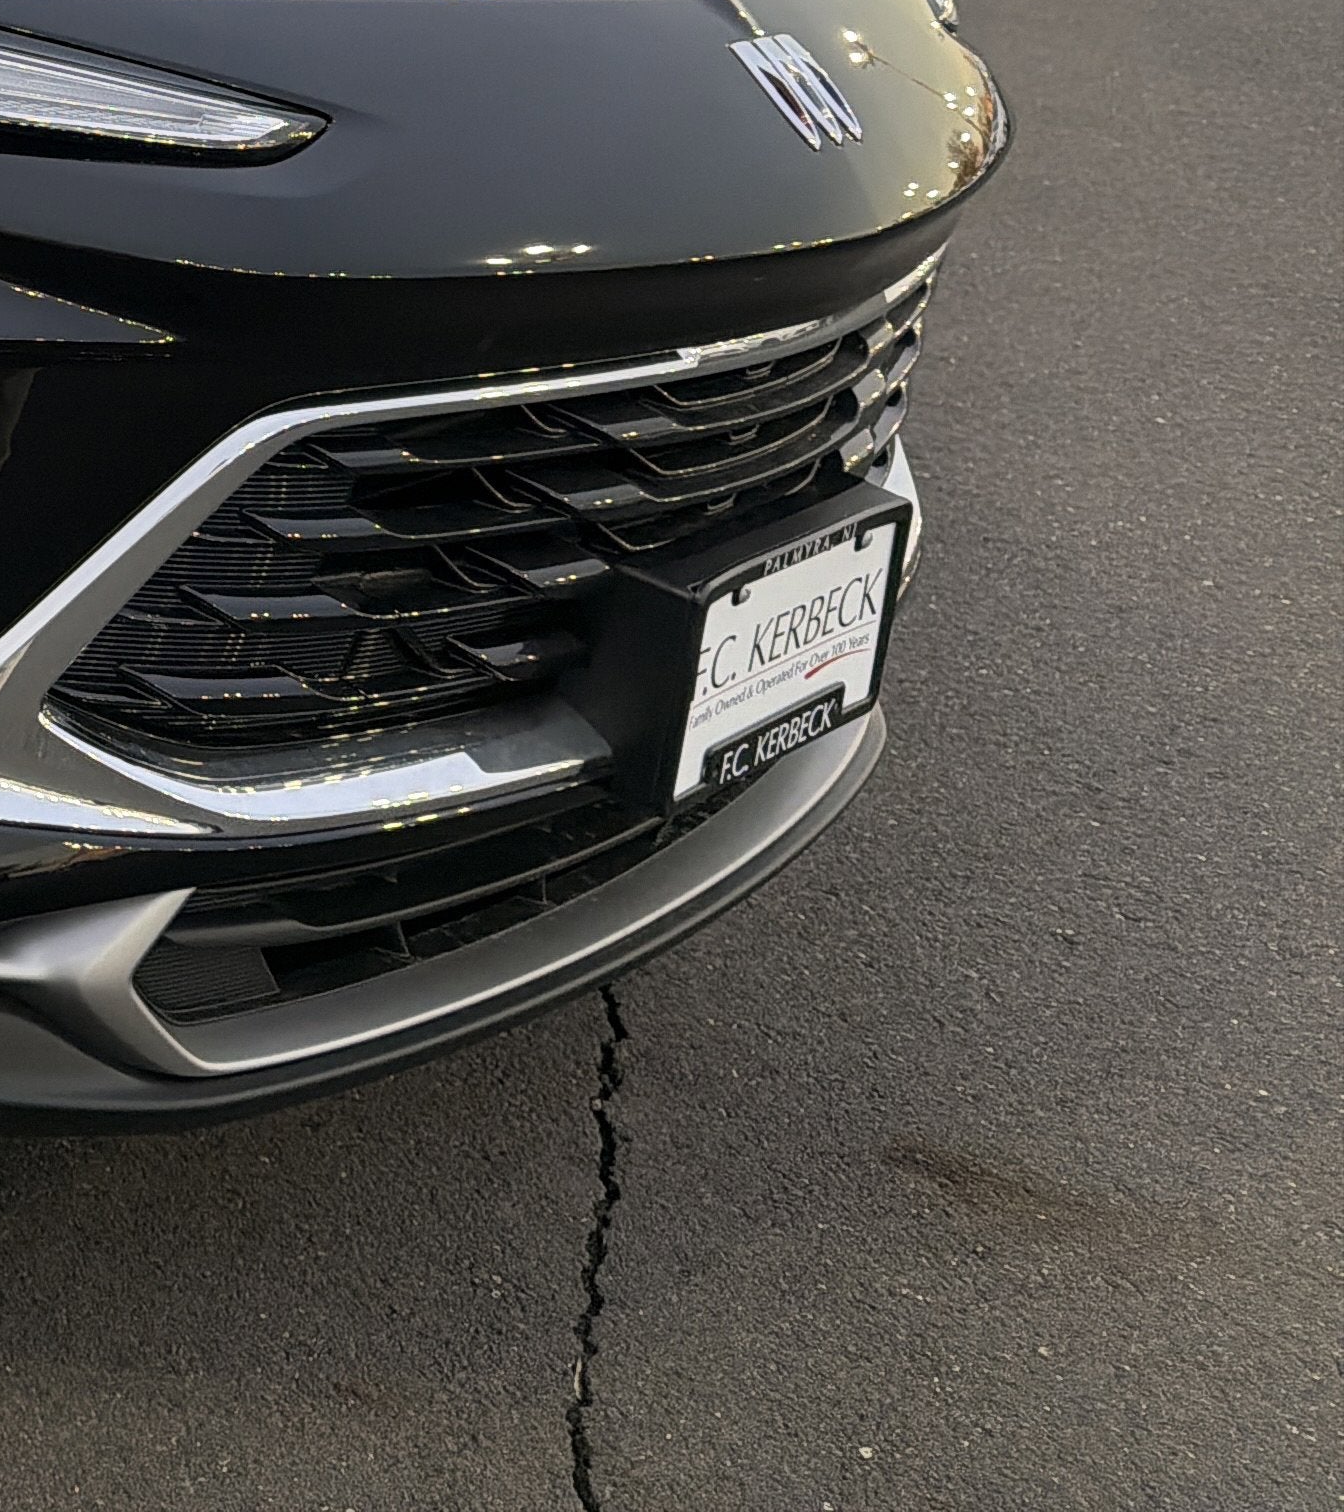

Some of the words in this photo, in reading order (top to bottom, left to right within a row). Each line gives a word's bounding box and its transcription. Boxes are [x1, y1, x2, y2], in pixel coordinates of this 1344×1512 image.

[747, 568, 883, 673] KERBECK
[714, 687, 745, 716] Owned
[744, 685, 755, 698] &
[755, 662, 798, 700] Operated
[794, 659, 809, 676] For
[808, 648, 829, 667] Over
[831, 639, 847, 658] 100
[847, 632, 870, 649] Years
[753, 698, 836, 767] KERBECK
